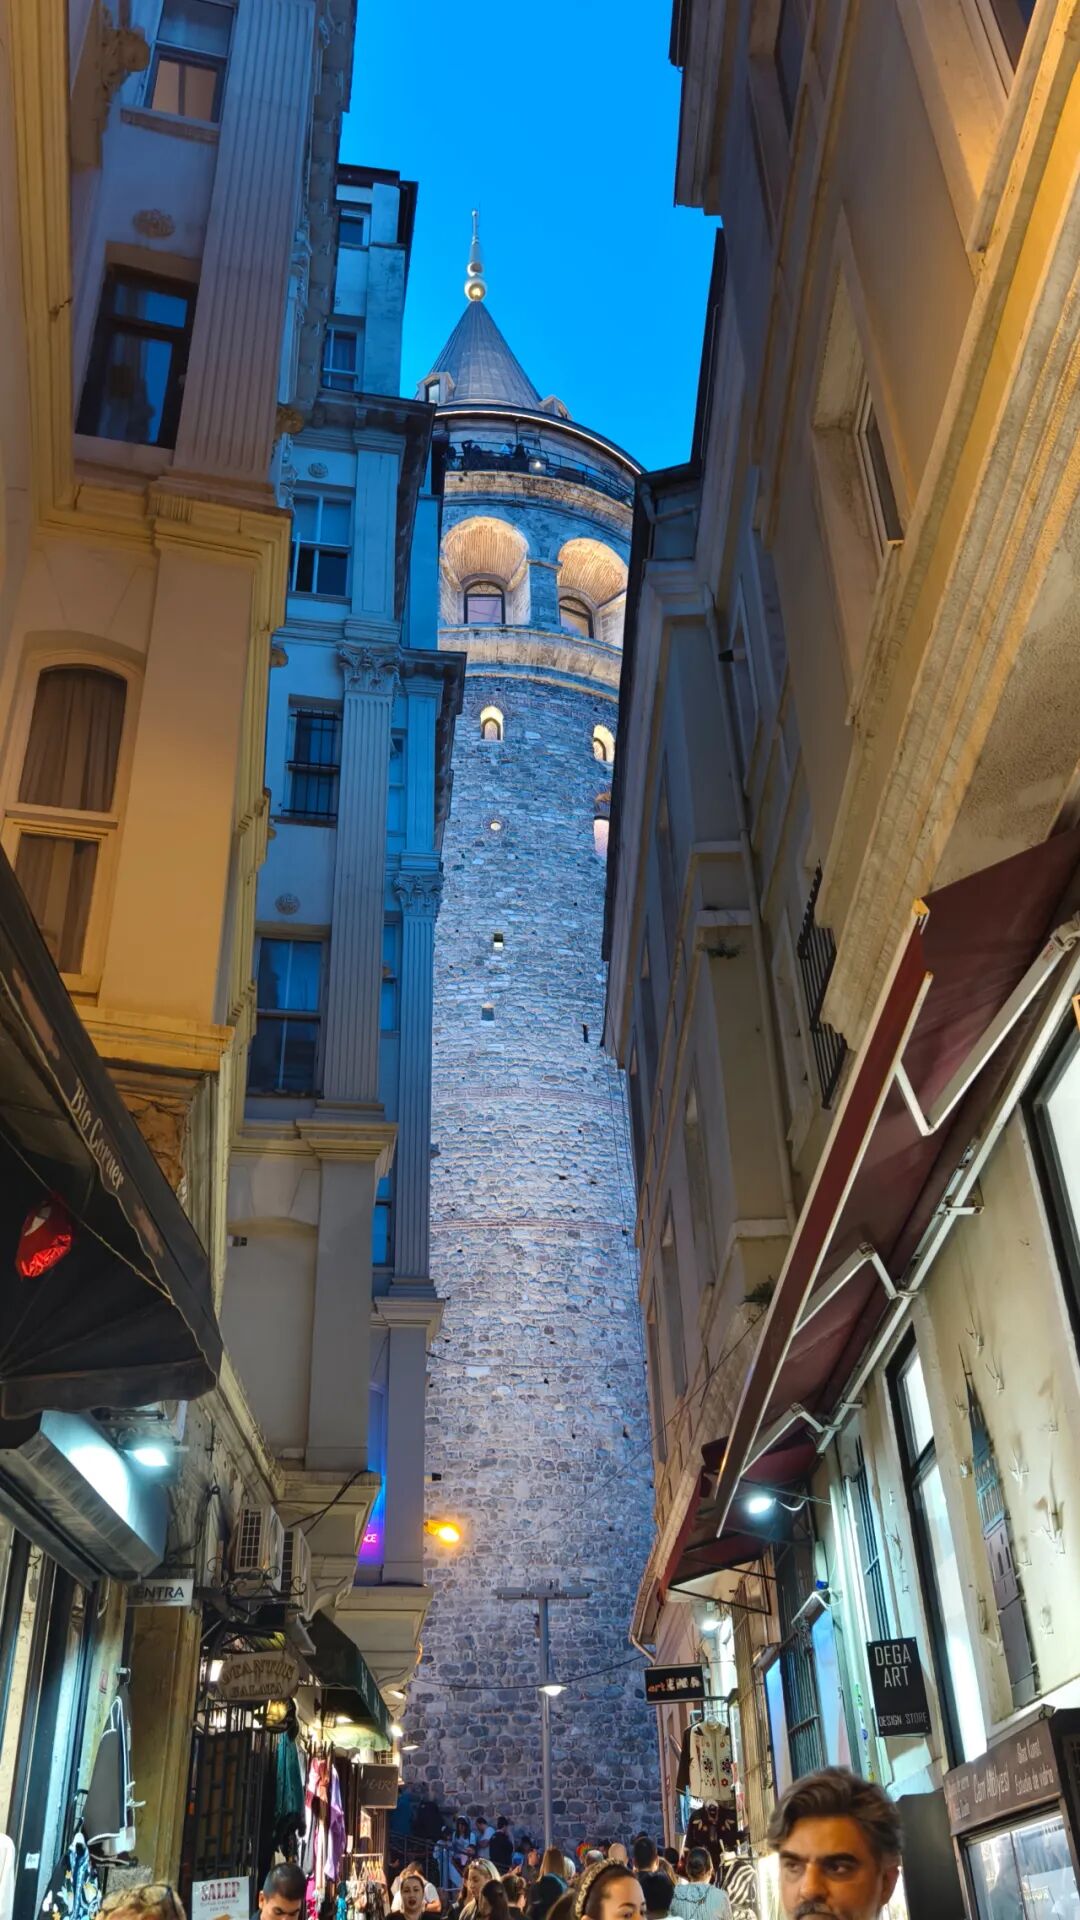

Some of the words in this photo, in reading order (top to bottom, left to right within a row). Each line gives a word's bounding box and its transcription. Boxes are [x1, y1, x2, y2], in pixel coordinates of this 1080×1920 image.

[90, 1117, 124, 1191] Corner
[874, 1643, 912, 1666] DEGA
[884, 1665, 909, 1688] ART
[878, 1714, 902, 1727] DESIGN
[904, 1711, 927, 1724] STORE
